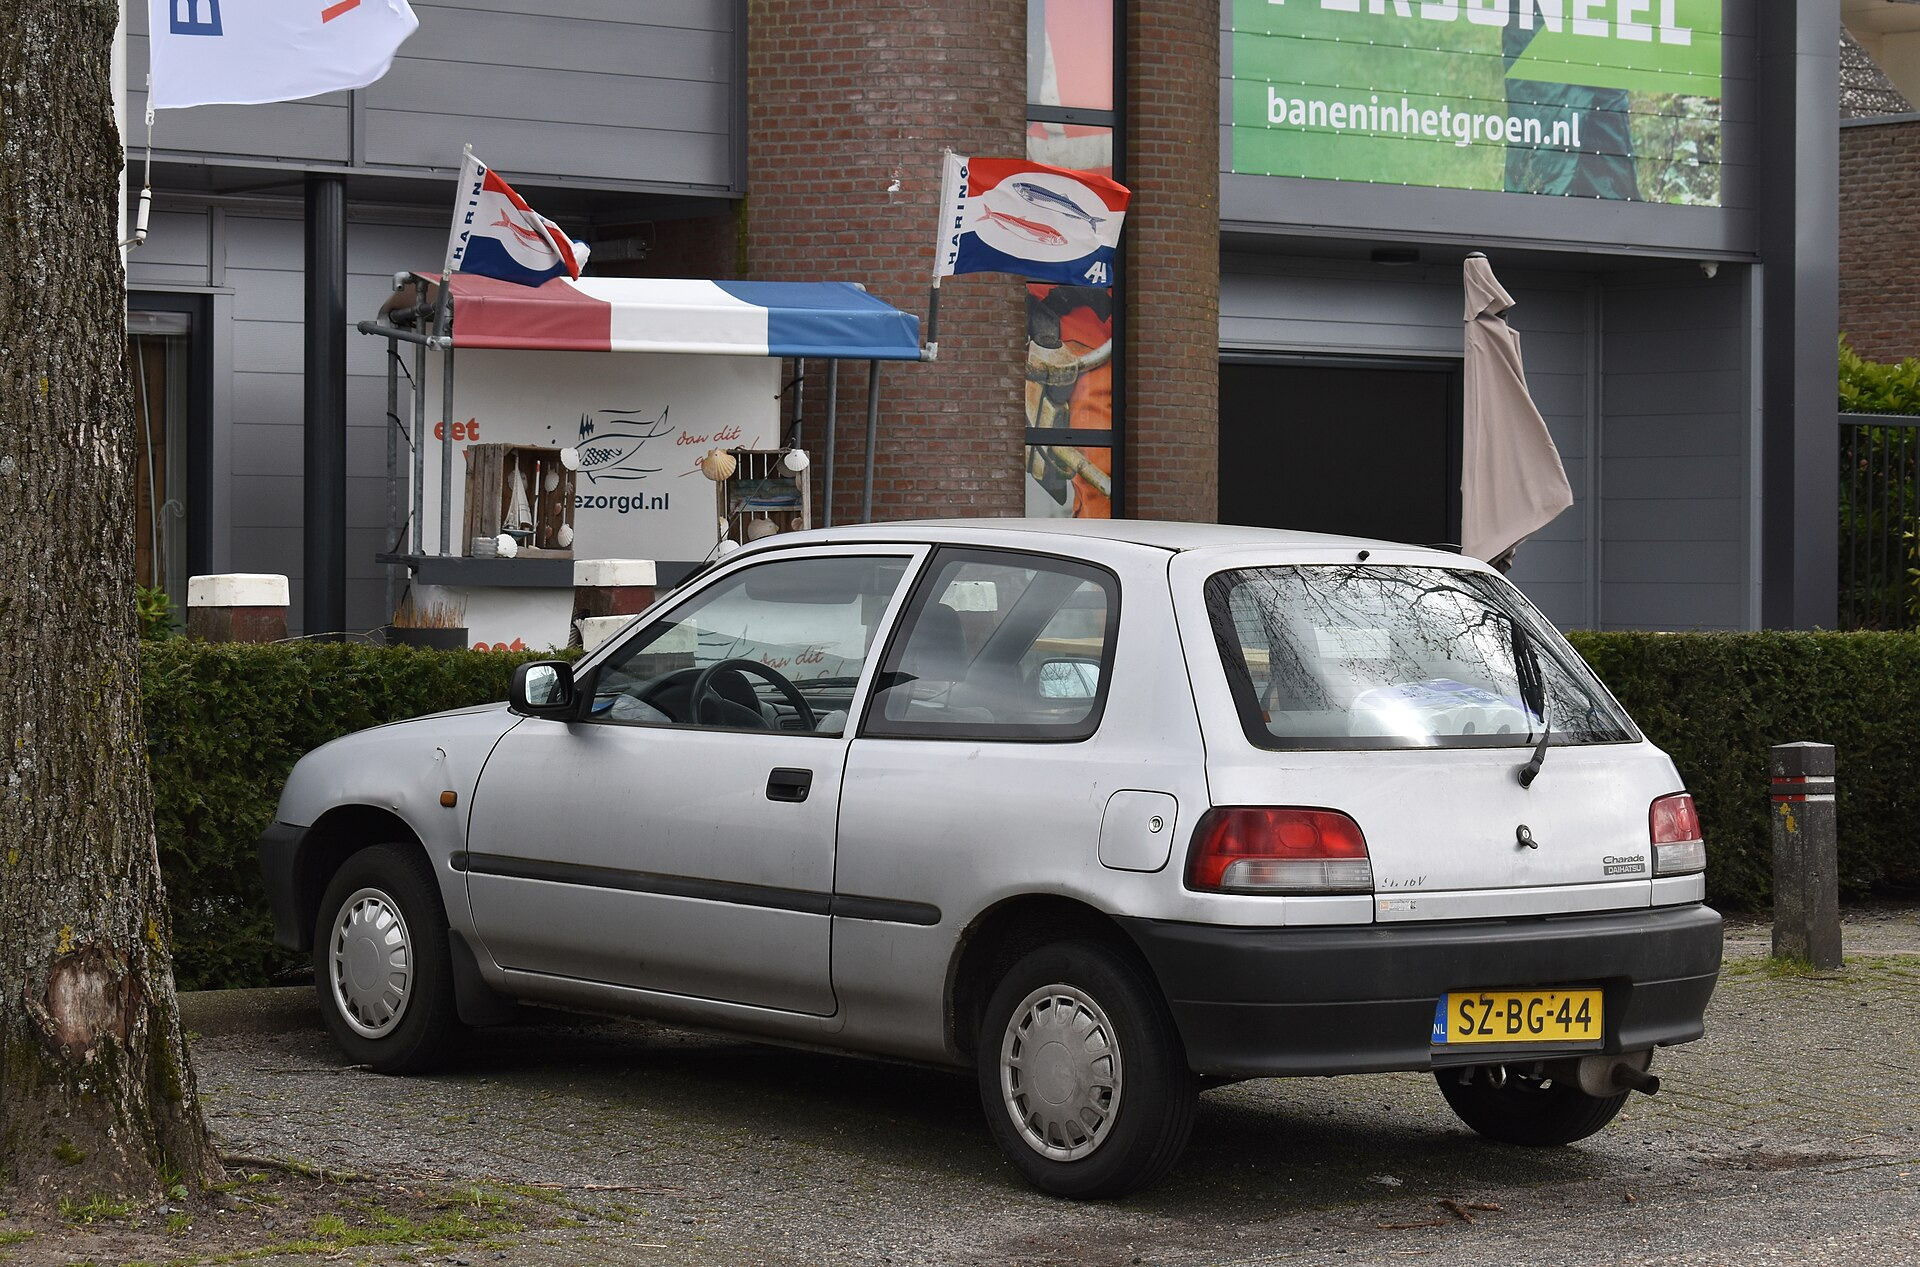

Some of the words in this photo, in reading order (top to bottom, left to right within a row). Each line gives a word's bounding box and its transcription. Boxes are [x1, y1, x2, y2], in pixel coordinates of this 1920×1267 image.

[1267, 86, 1581, 147] baneninhetgroen.nl
[453, 164, 485, 260] HARING
[948, 165, 968, 265] HARING
[574, 492, 669, 514] ezorgd.nl
[1602, 854, 1645, 864] Charade
[1608, 864, 1642, 874] DAIHATSU
[1433, 1023, 1446, 1035] NL
[1458, 997, 1592, 1036] SZ-BG-44
